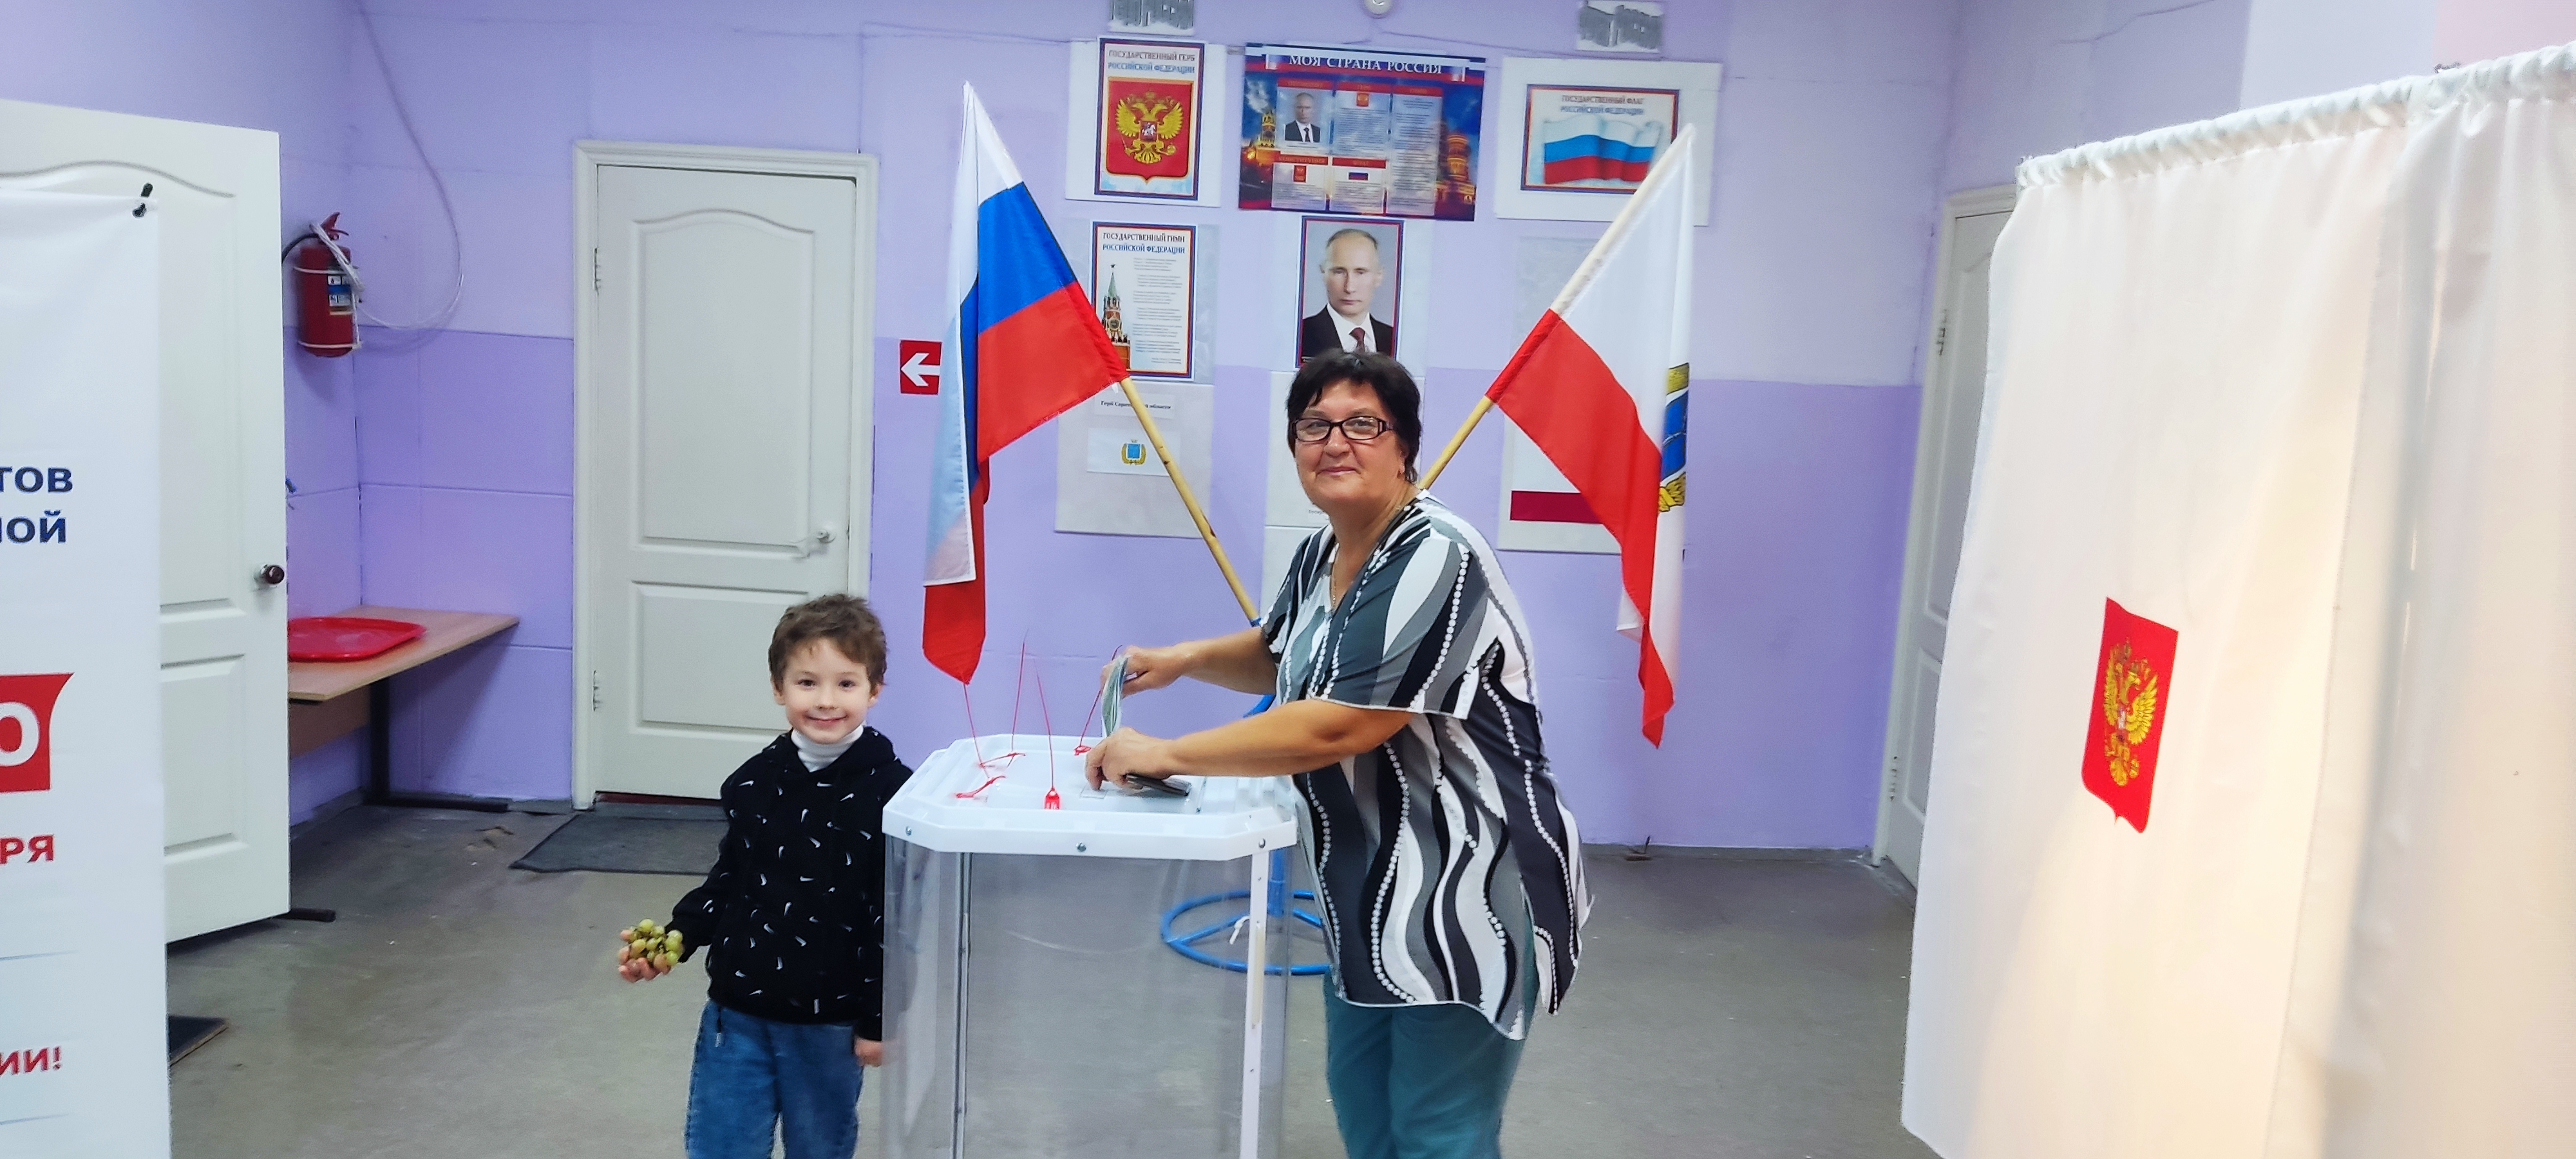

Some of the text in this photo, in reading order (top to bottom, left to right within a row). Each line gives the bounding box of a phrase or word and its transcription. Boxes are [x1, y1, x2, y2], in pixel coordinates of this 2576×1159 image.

[1289, 55, 1442, 74] МОЯ СТРАНА РОССИЯ
[1103, 232, 1166, 242] ГОСУДАРСТВЕННЫЙ
[1103, 243, 1185, 255] РОССИЙСКОЙ ФЕДЕРАЦИИ
[0, 509, 66, 543] ОЙ
